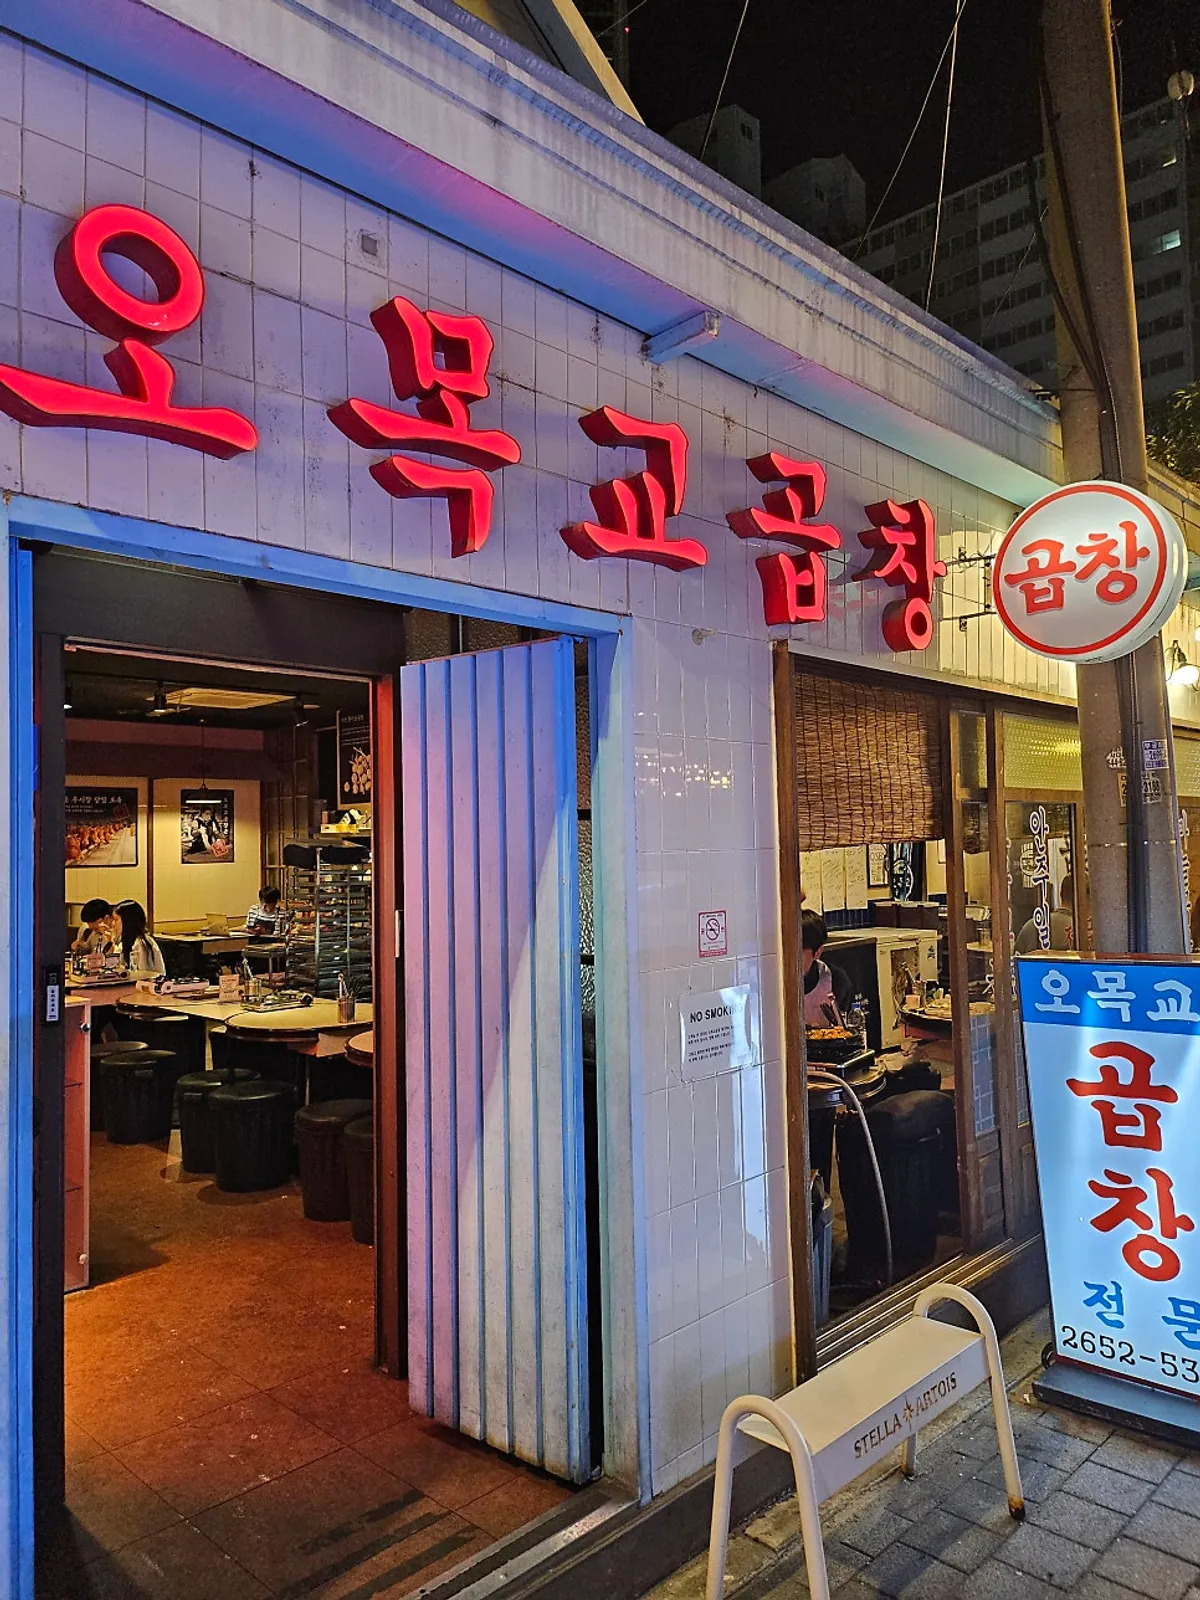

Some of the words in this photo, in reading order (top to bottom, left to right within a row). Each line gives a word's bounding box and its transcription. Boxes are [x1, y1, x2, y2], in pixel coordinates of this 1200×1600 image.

[1004, 520, 1151, 615] 곱창
[690, 1011, 703, 1023] NO
[1034, 969, 1200, 1022] 오목교
[1065, 1041, 1195, 1281] 곱창
[1061, 1325, 1200, 1384] 2652-53
[854, 1413, 902, 1459] STELLA
[916, 1372, 957, 1416] ARTOIS
